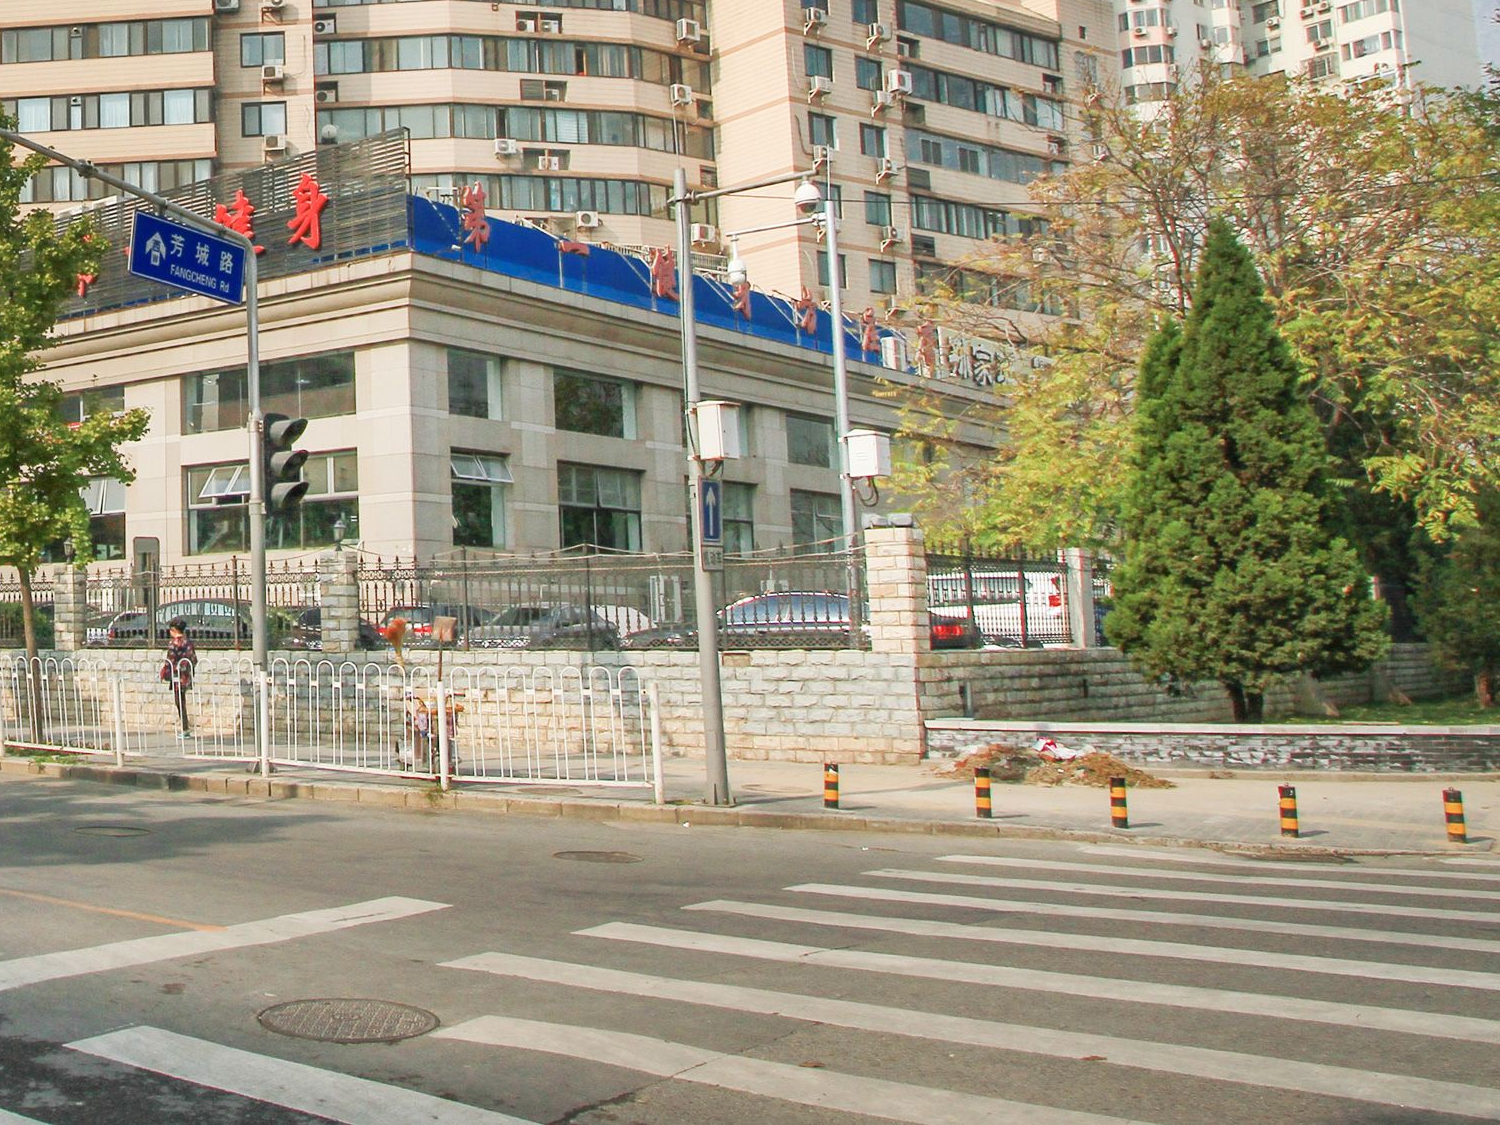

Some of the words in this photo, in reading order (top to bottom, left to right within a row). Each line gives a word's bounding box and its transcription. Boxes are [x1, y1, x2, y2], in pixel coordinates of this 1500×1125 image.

[170, 233, 234, 275] 芳城路
[170, 264, 217, 289] FANGCHENG
[220, 280, 230, 293] Rd
